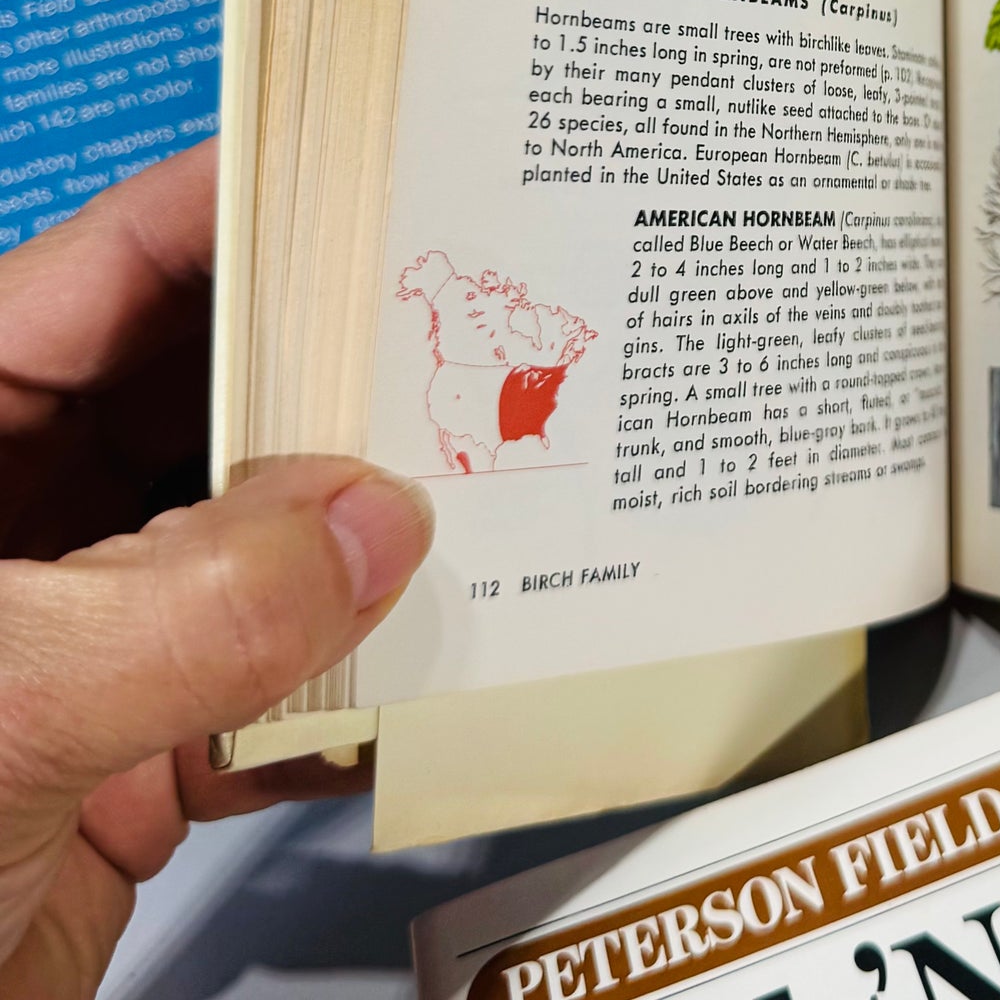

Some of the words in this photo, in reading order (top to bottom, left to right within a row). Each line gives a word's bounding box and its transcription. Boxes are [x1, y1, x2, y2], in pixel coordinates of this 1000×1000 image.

[14, 25, 71, 55] other
[536, 6, 636, 33] Hornbeams
[643, 18, 671, 35] are
[678, 16, 718, 40] small
[724, 25, 760, 44] trees
[766, 28, 794, 47] with
[799, 31, 851, 54] birchlike
[854, 39, 889, 59] leaves.
[3, 57, 60, 84] more
[4, 78, 88, 113] families
[93, 67, 129, 90] are
[134, 55, 171, 78] not
[79, 99, 116, 123] are
[81, 125, 176, 164] chapters
[522, 165, 592, 186] planted
[600, 168, 615, 184] in
[623, 168, 649, 185] the
[657, 167, 710, 186] United
[717, 169, 763, 187] States
[768, 173, 784, 188] as
[790, 175, 807, 189] an
[813, 172, 877, 191] ornamental
[633, 210, 737, 227] AMERICAN
[743, 210, 836, 227] HORNBEAM
[633, 235, 684, 253] called
[690, 234, 723, 251] Blue
[729, 234, 773, 252] Beech
[778, 239, 793, 251] or
[798, 234, 838, 251] Water
[623, 338, 664, 358] gins.
[676, 334, 704, 352] The
[717, 330, 803, 351] light-green,
[813, 325, 845, 346] leafy
[618, 415, 653, 432] ican
[666, 408, 752, 428] Hornbeam
[764, 403, 789, 420] has
[799, 405, 807, 418] a
[817, 398, 853, 416] short,
[613, 491, 663, 511] moist,
[672, 486, 702, 504] rich
[709, 480, 737, 500] soil
[745, 474, 819, 497] bordering
[824, 466, 872, 487] streams
[471, 580, 500, 599] 112
[522, 570, 574, 592] BIRCH
[581, 561, 641, 584] FAMILY
[501, 856, 826, 1000] PETERSON
